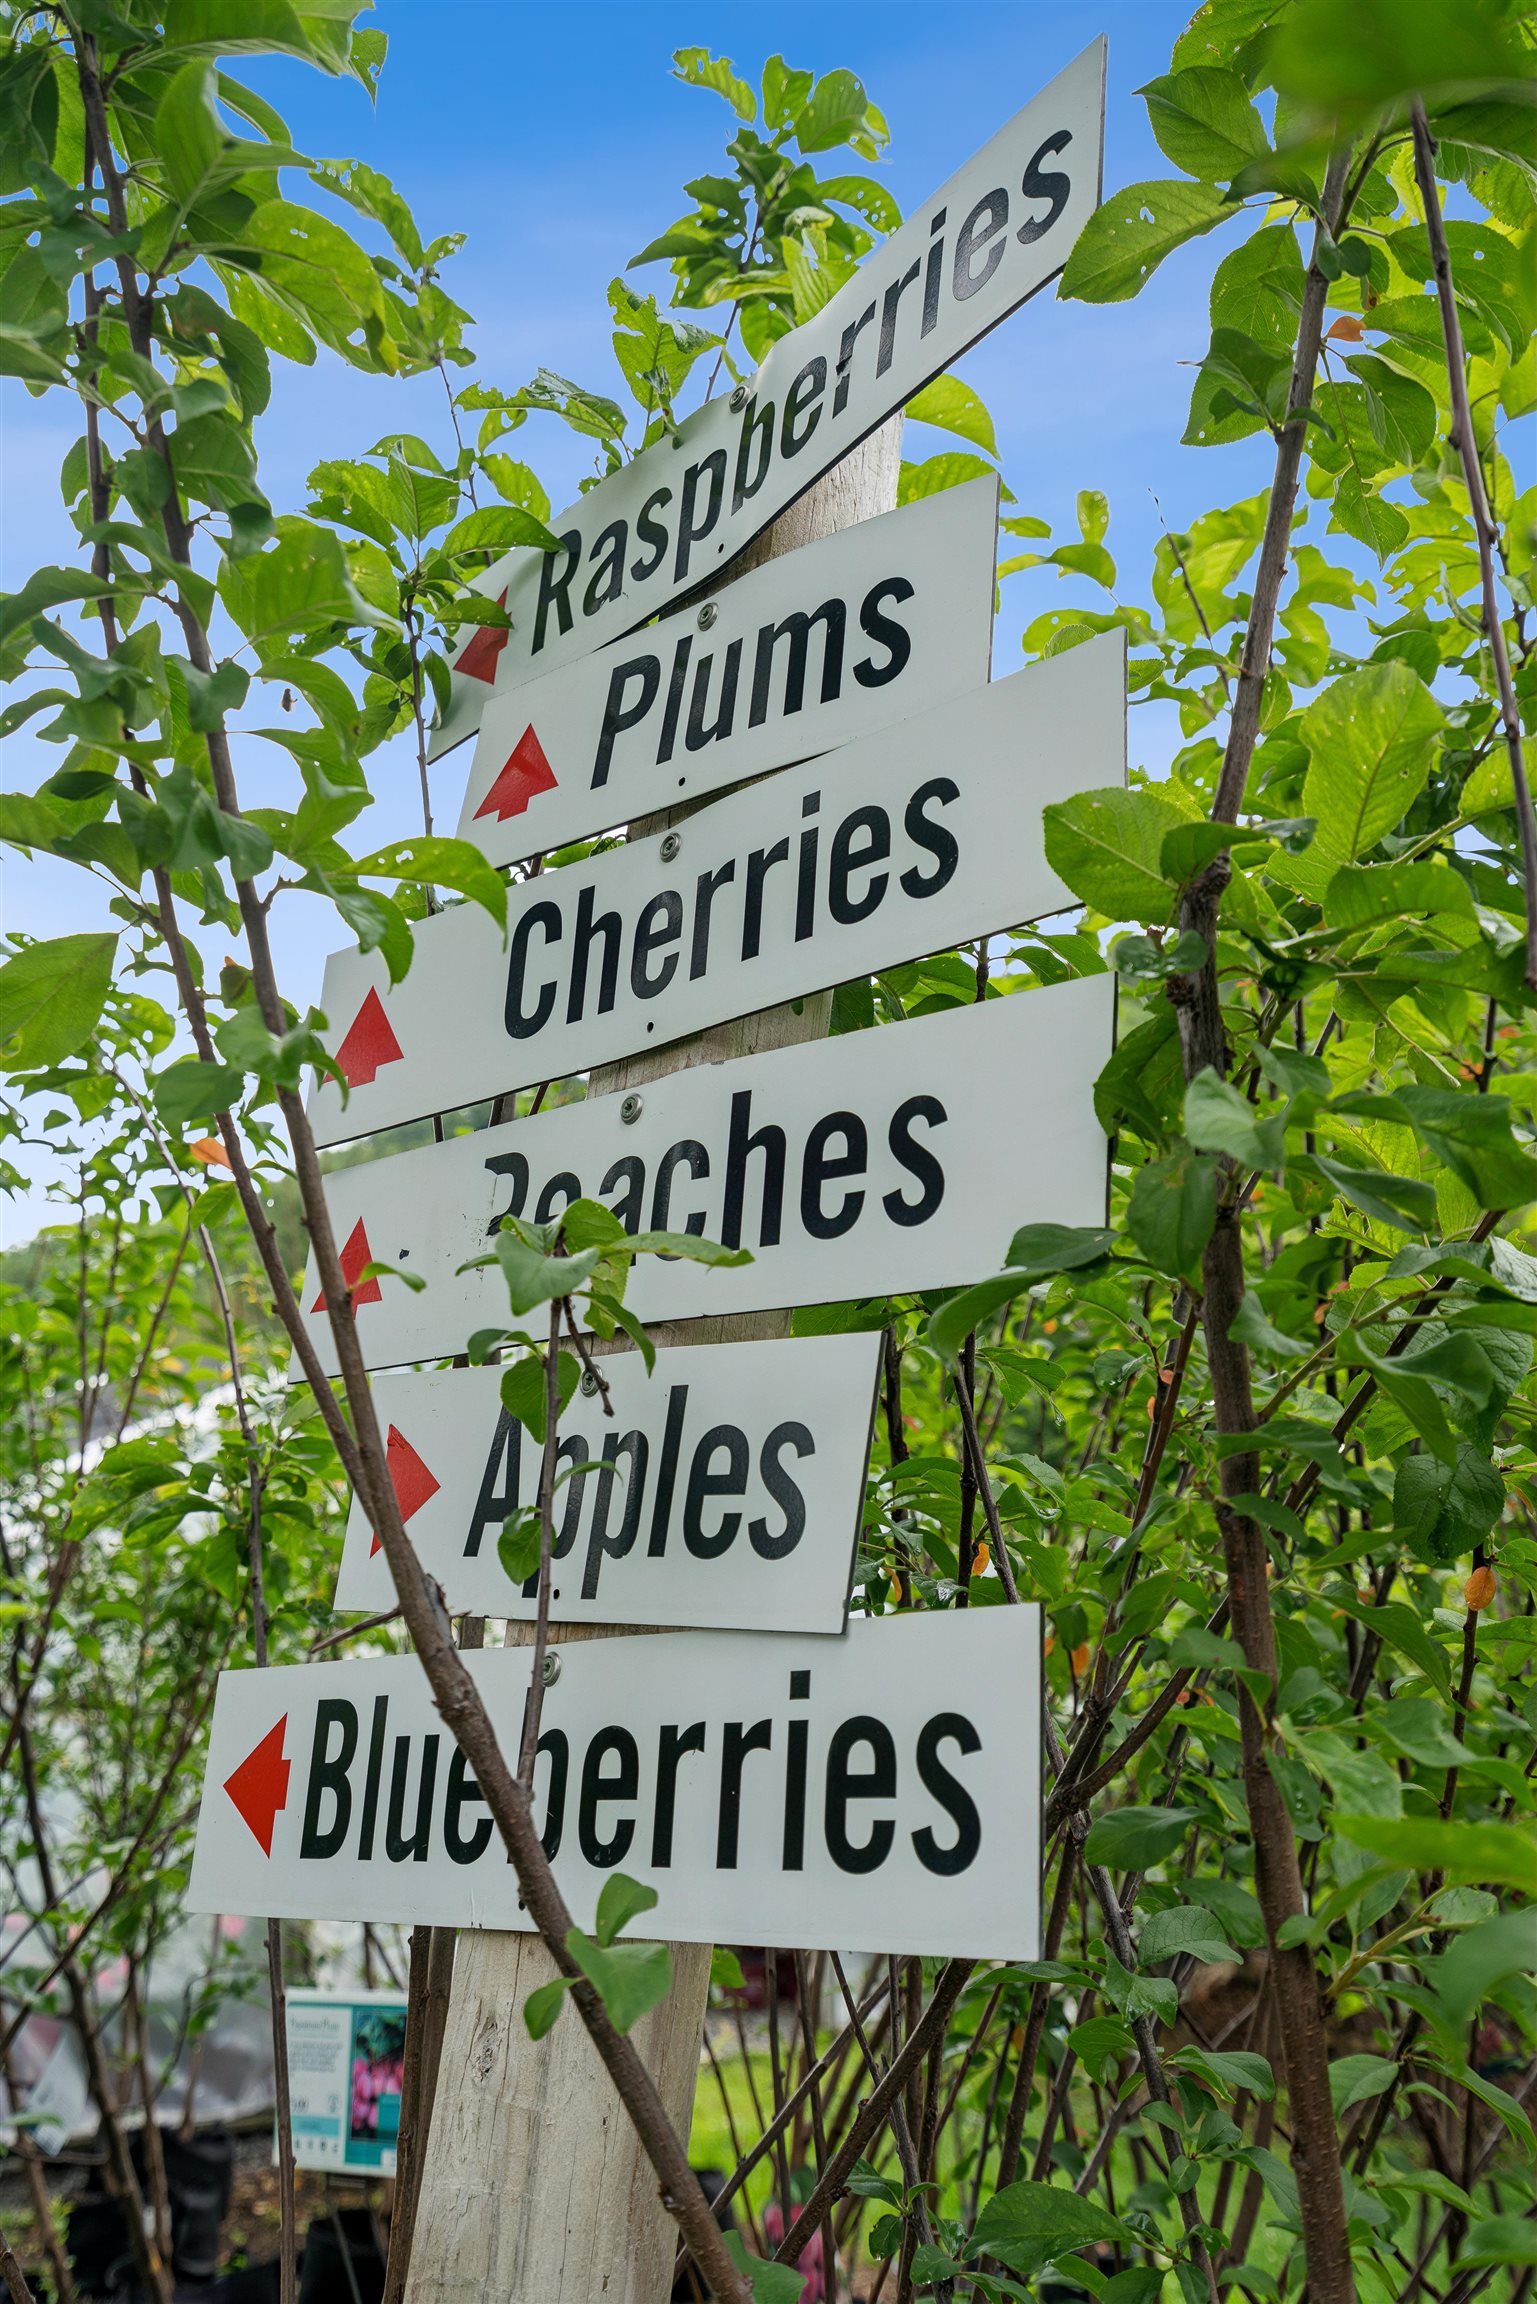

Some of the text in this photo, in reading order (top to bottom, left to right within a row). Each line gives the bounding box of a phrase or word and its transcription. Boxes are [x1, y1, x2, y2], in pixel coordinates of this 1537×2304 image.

[531, 129, 1073, 656] Raspberries
[590, 577, 915, 790] Plums
[504, 777, 960, 1040] Cherries
[463, 1385, 815, 1599] Apples
[300, 1670, 982, 1877] Blueberries
